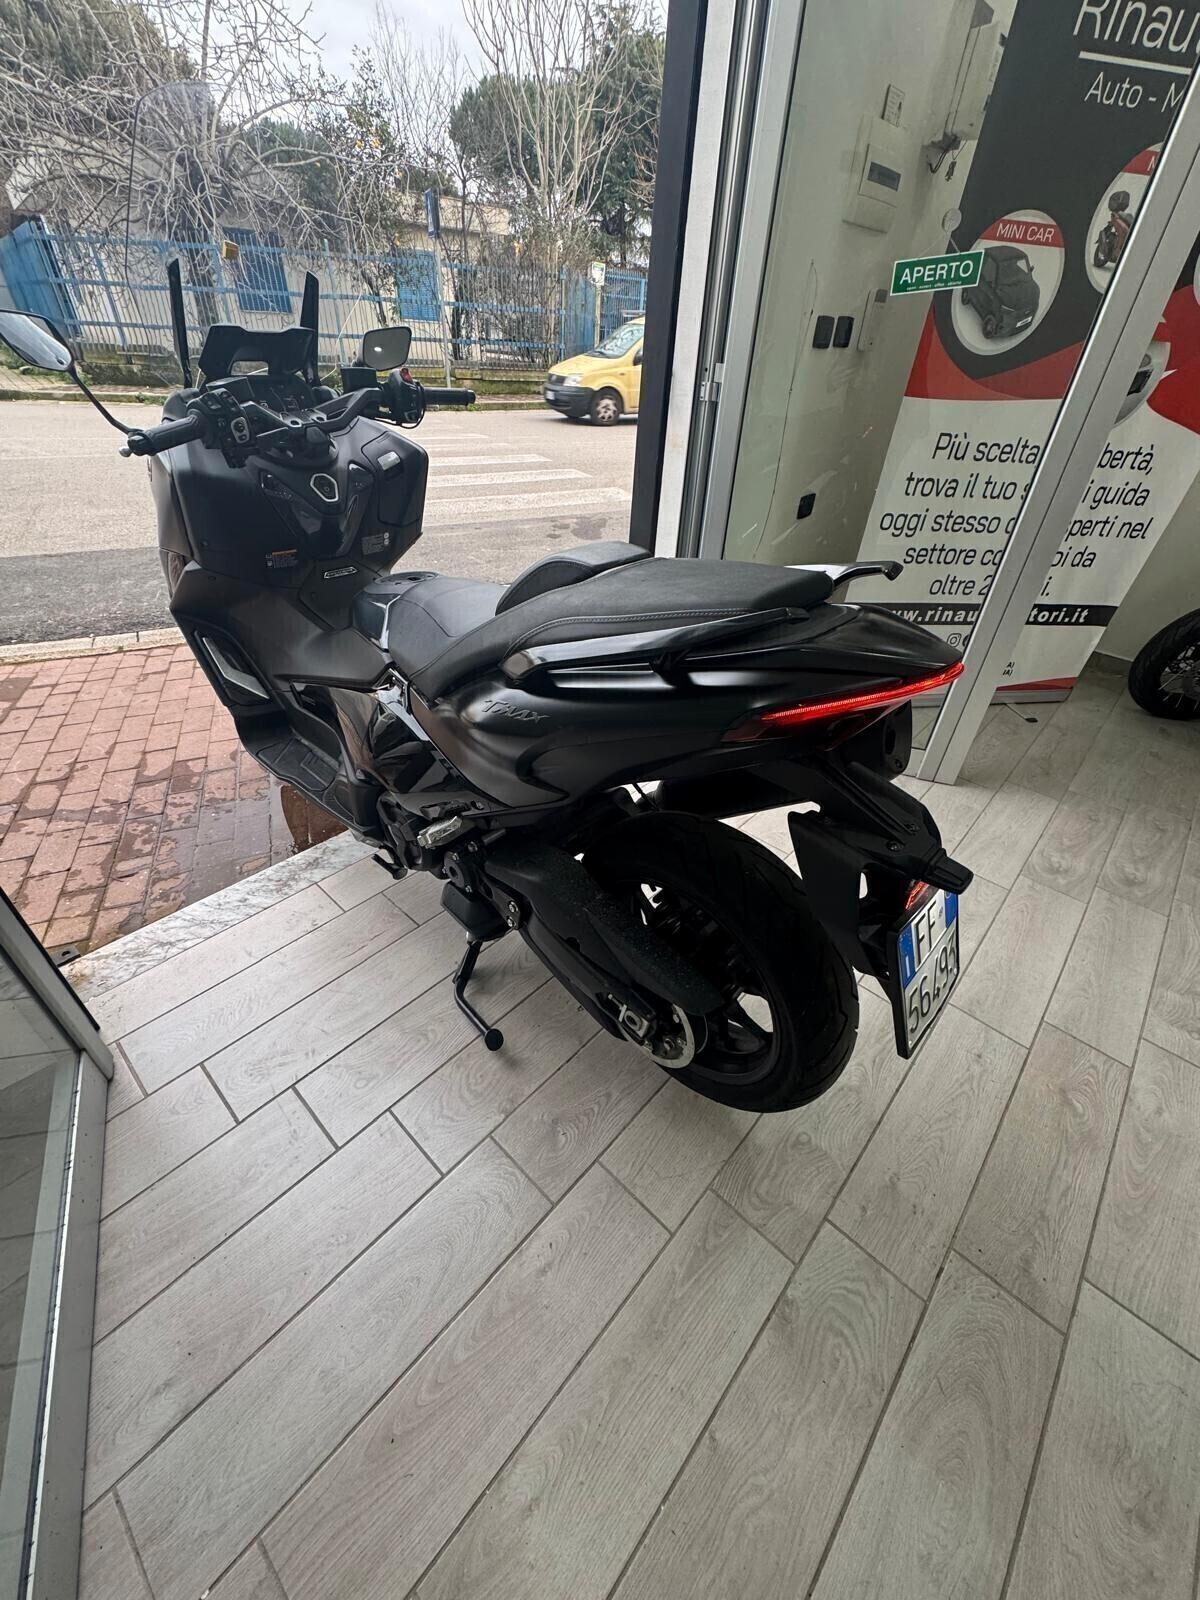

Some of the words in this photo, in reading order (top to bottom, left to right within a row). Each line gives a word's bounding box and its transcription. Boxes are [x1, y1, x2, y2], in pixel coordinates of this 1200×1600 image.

[1073, 0, 1200, 54] Rinau
[1084, 71, 1143, 108] Auto
[1161, 82, 1184, 112] M
[996, 223, 1024, 240] MINI
[1026, 226, 1055, 243] CAR
[900, 260, 974, 285] APERTO
[932, 432, 970, 461] Più
[1097, 442, 1154, 475] bertà,
[904, 471, 959, 498] trova
[963, 473, 980, 498] il
[982, 475, 1017, 500] tuo
[1082, 479, 1095, 504] i
[1089, 481, 1150, 510] guida
[879, 508, 929, 538] oggi
[931, 510, 1000, 534] stesso
[1064, 515, 1119, 542] perti
[1116, 517, 1154, 540] nel
[903, 543, 977, 565] settore
[980, 549, 1004, 566] co
[1050, 546, 1073, 568] oi
[1070, 546, 1097, 568] da
[929, 574, 976, 596] oltre
[978, 574, 994, 596] 2
[1040, 576, 1053, 597] i.
[1028, 608, 1089, 623] tori.it
[915, 900, 937, 968] FF
[909, 930, 956, 1034] 56493
